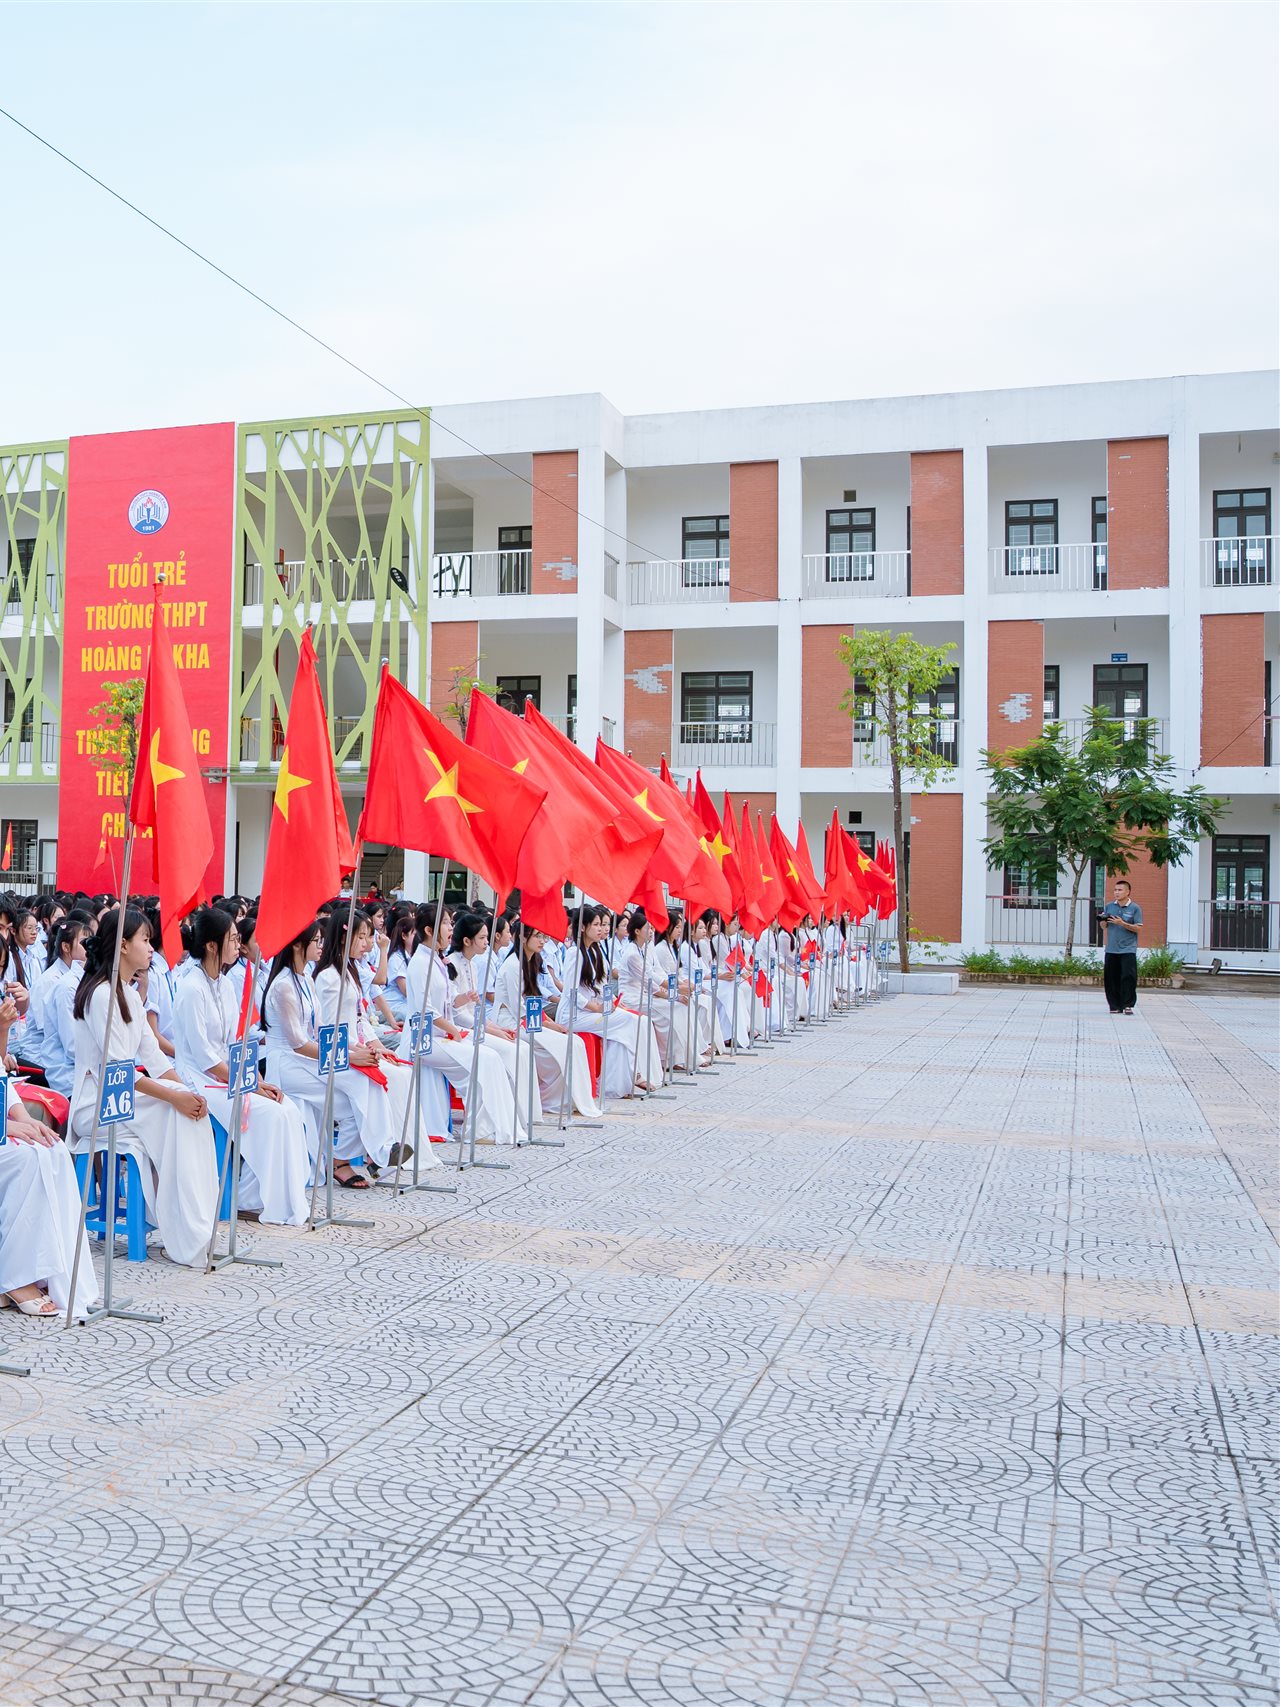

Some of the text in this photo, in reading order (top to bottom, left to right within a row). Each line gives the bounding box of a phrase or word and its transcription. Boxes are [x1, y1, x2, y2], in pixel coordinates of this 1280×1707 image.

[107, 550, 187, 589] TUỔI TRẺ
[85, 598, 208, 631] TRƯỜNG THPT
[81, 641, 142, 673] HOÀNG
[172, 643, 210, 670] KHA
[528, 1015, 541, 1029] A1
[107, 1068, 128, 1086] LỚP
[102, 1091, 132, 1118] A6
